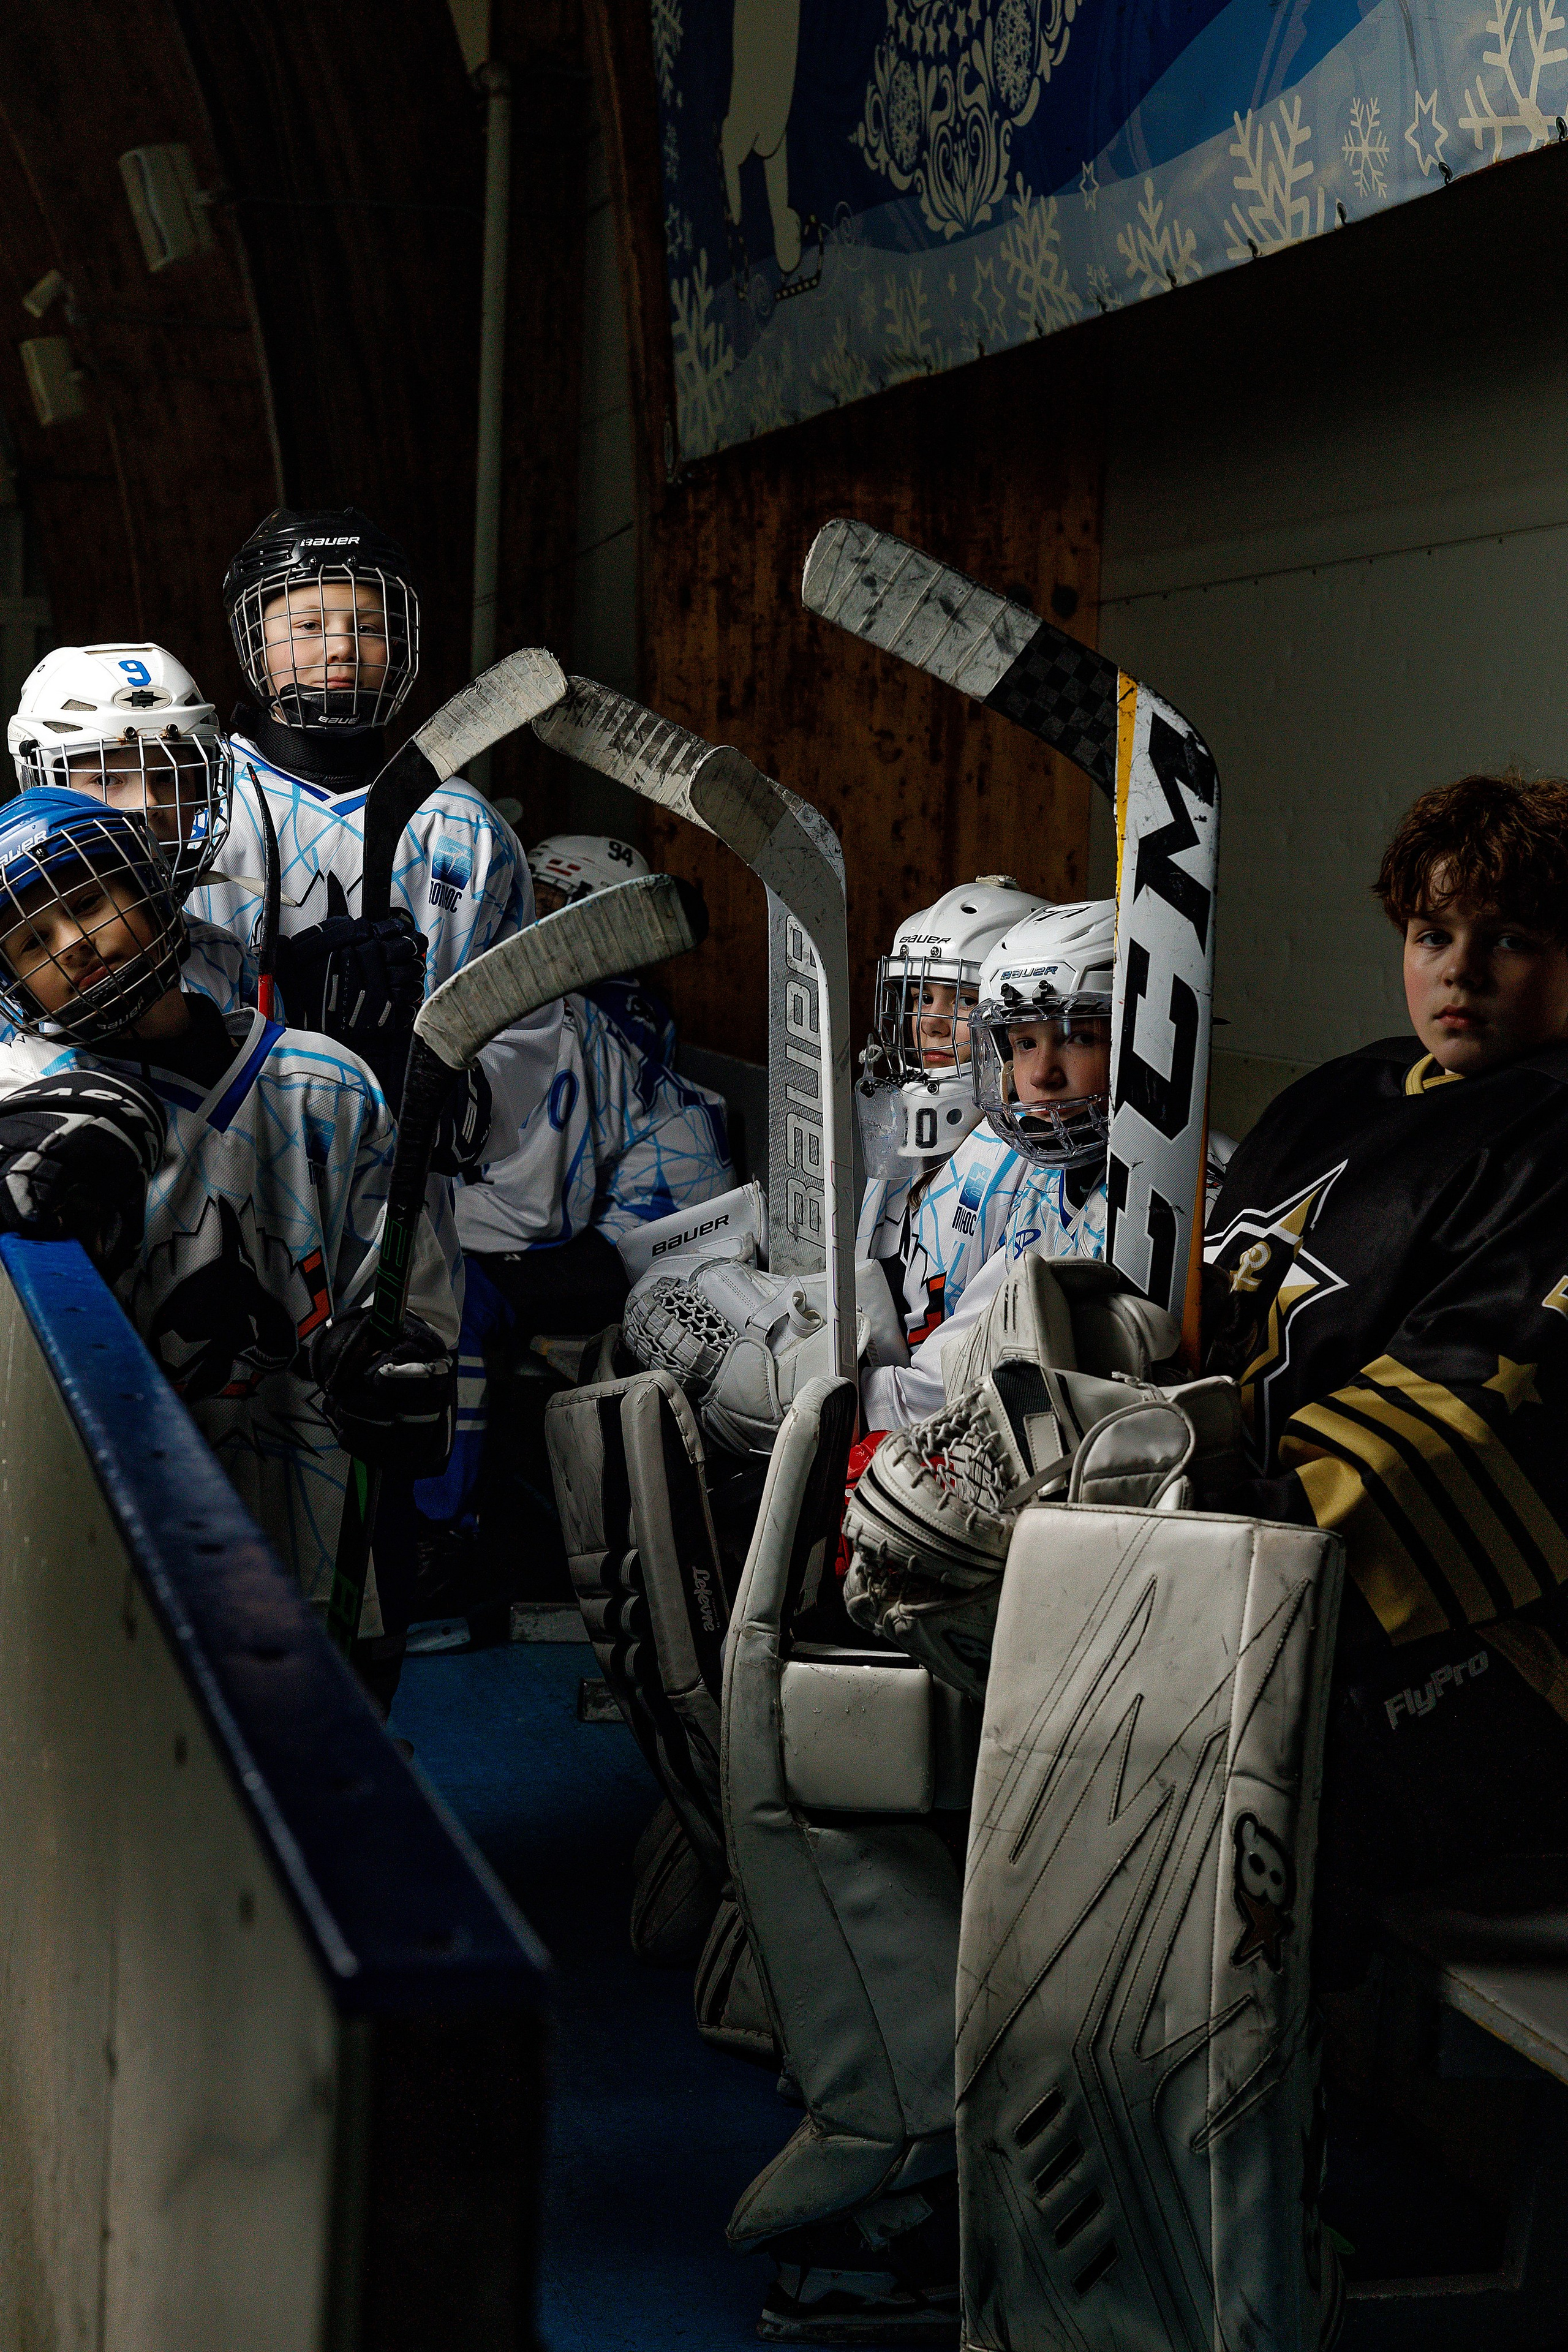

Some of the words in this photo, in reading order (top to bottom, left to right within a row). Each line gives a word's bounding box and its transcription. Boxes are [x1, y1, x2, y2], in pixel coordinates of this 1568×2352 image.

[300, 537, 360, 547] BAUER
[118, 660, 152, 687] 9
[318, 715, 359, 725] BAUE
[0, 830, 48, 866] AUER
[608, 841, 633, 867] 94
[899, 935, 952, 944] BAUER
[1000, 966, 1058, 981] BAUER
[652, 1214, 729, 1257] BAUER
